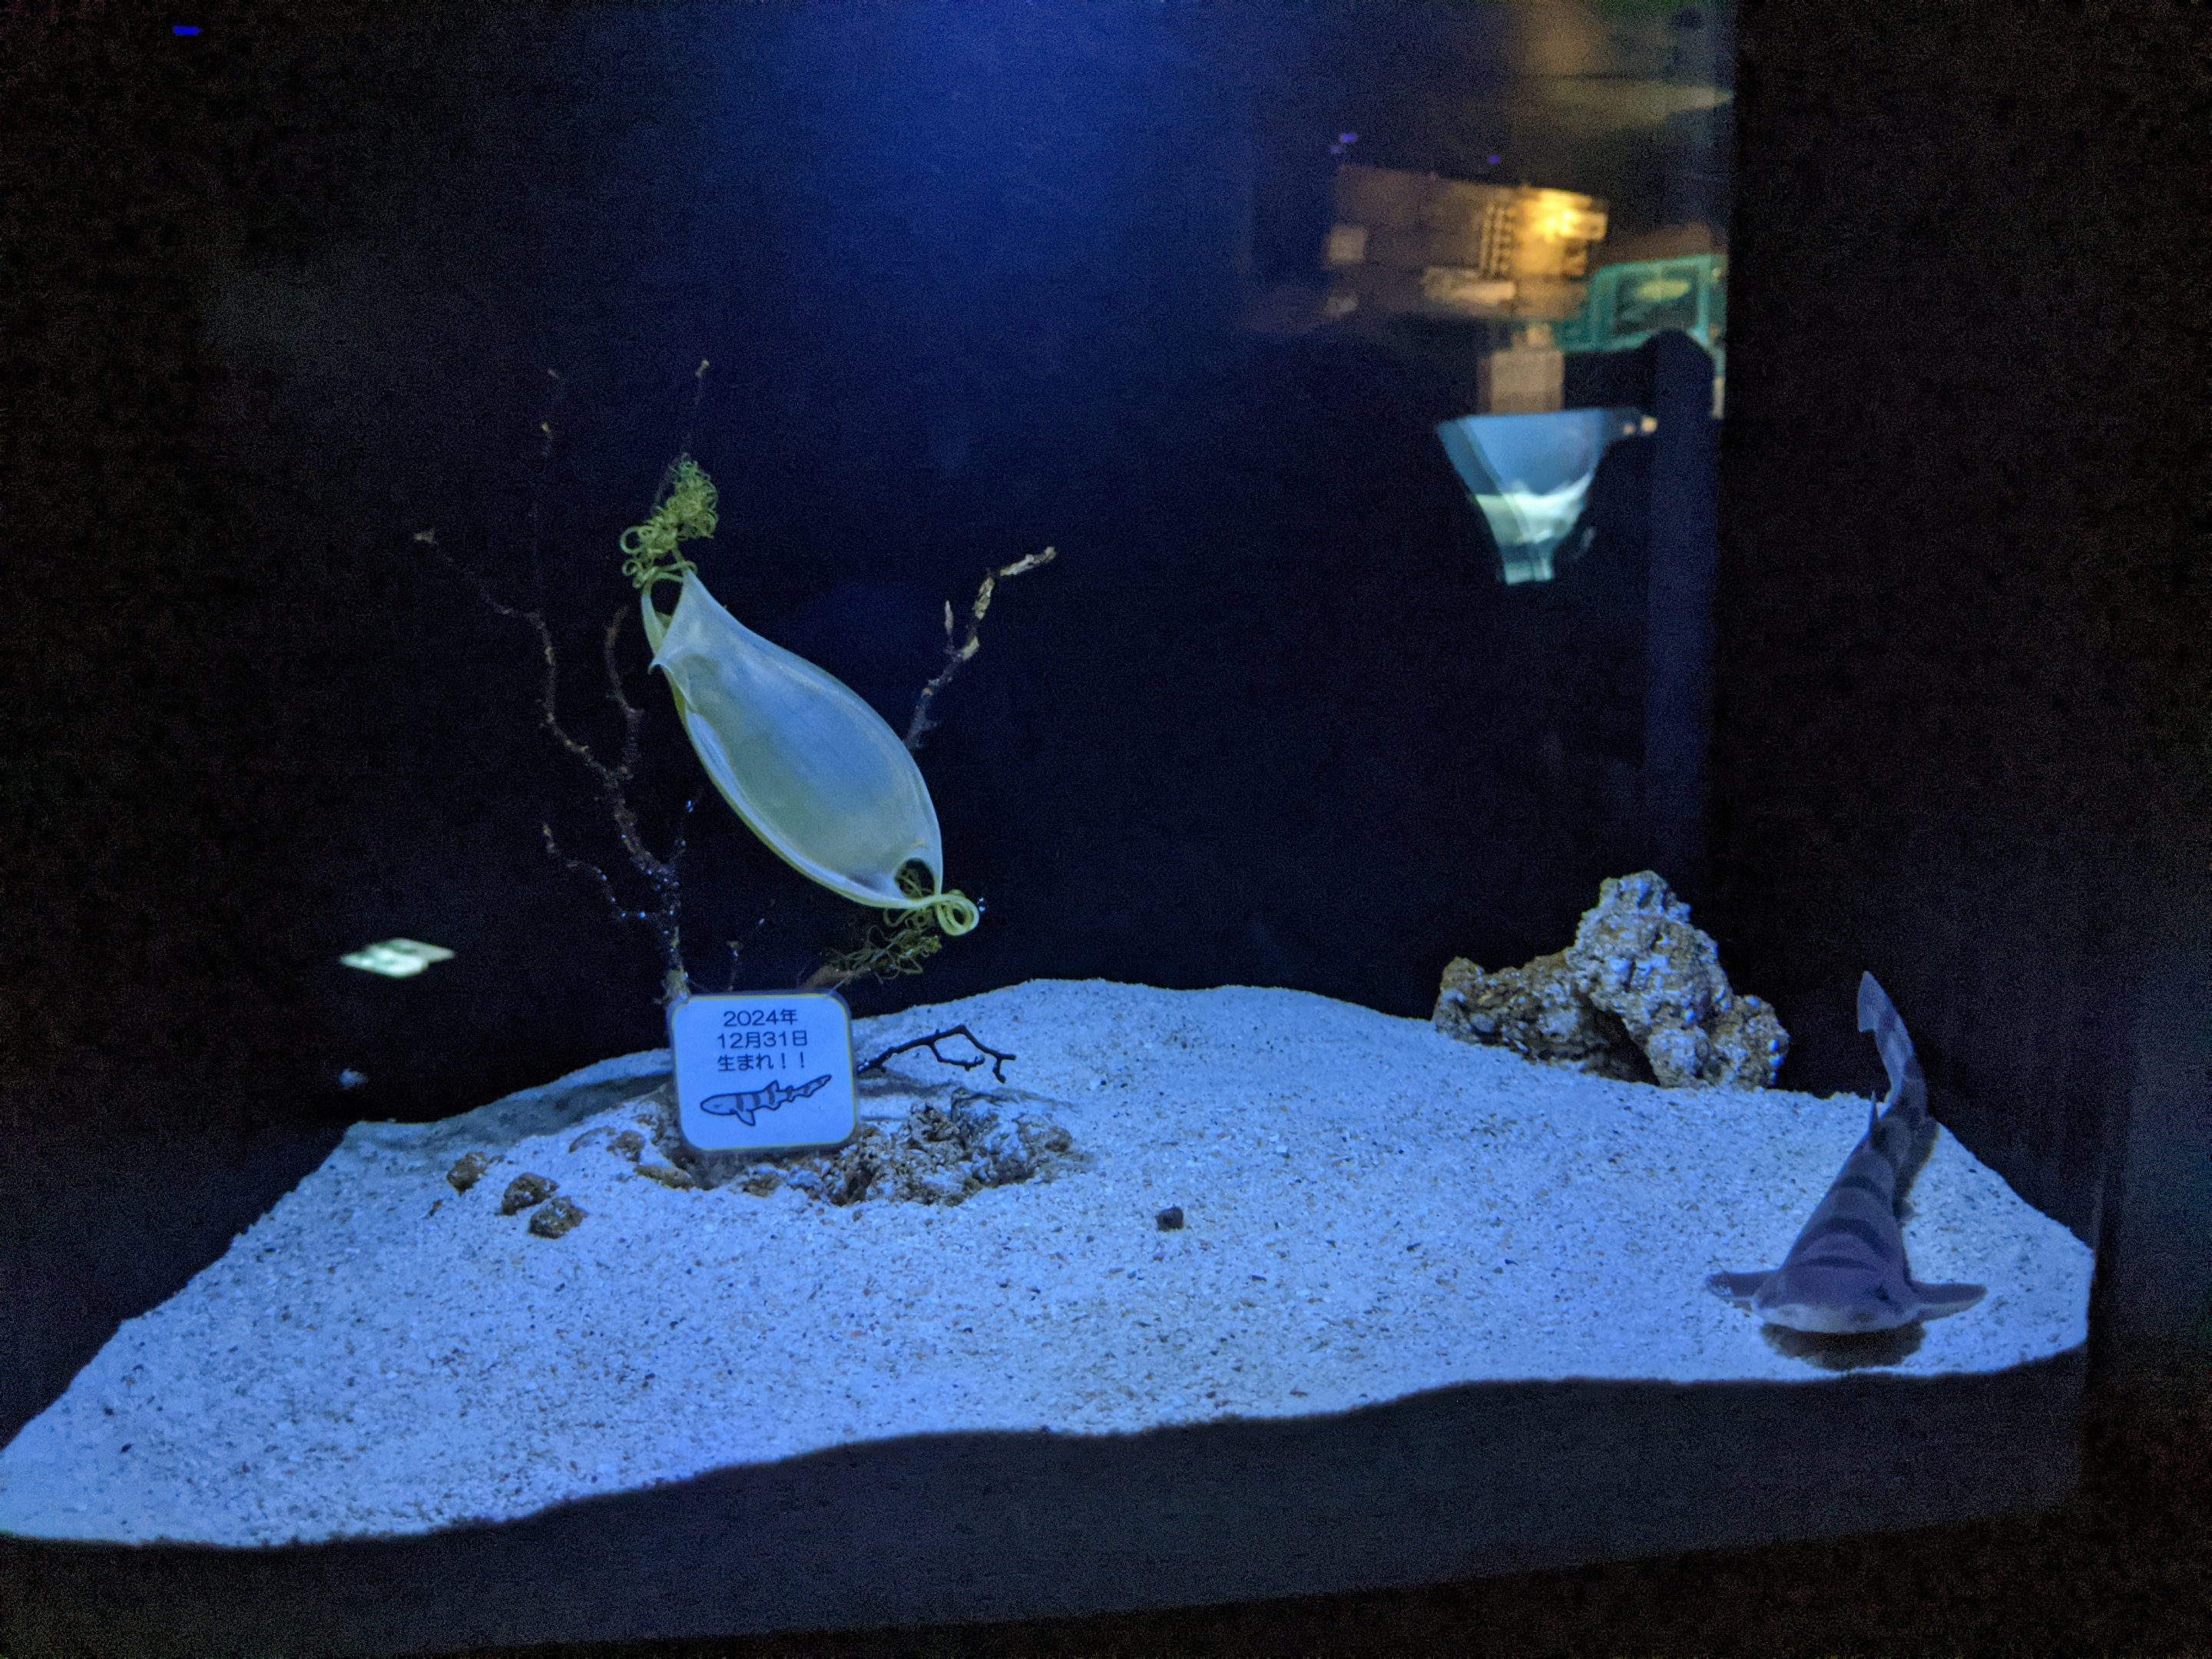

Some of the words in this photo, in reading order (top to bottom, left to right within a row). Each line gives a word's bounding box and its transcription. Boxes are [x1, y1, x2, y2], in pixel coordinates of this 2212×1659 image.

[724, 1008, 797, 1027] 2024年
[717, 1030, 807, 1048] 12月31日
[717, 1051, 805, 1071] 生まれ！！
